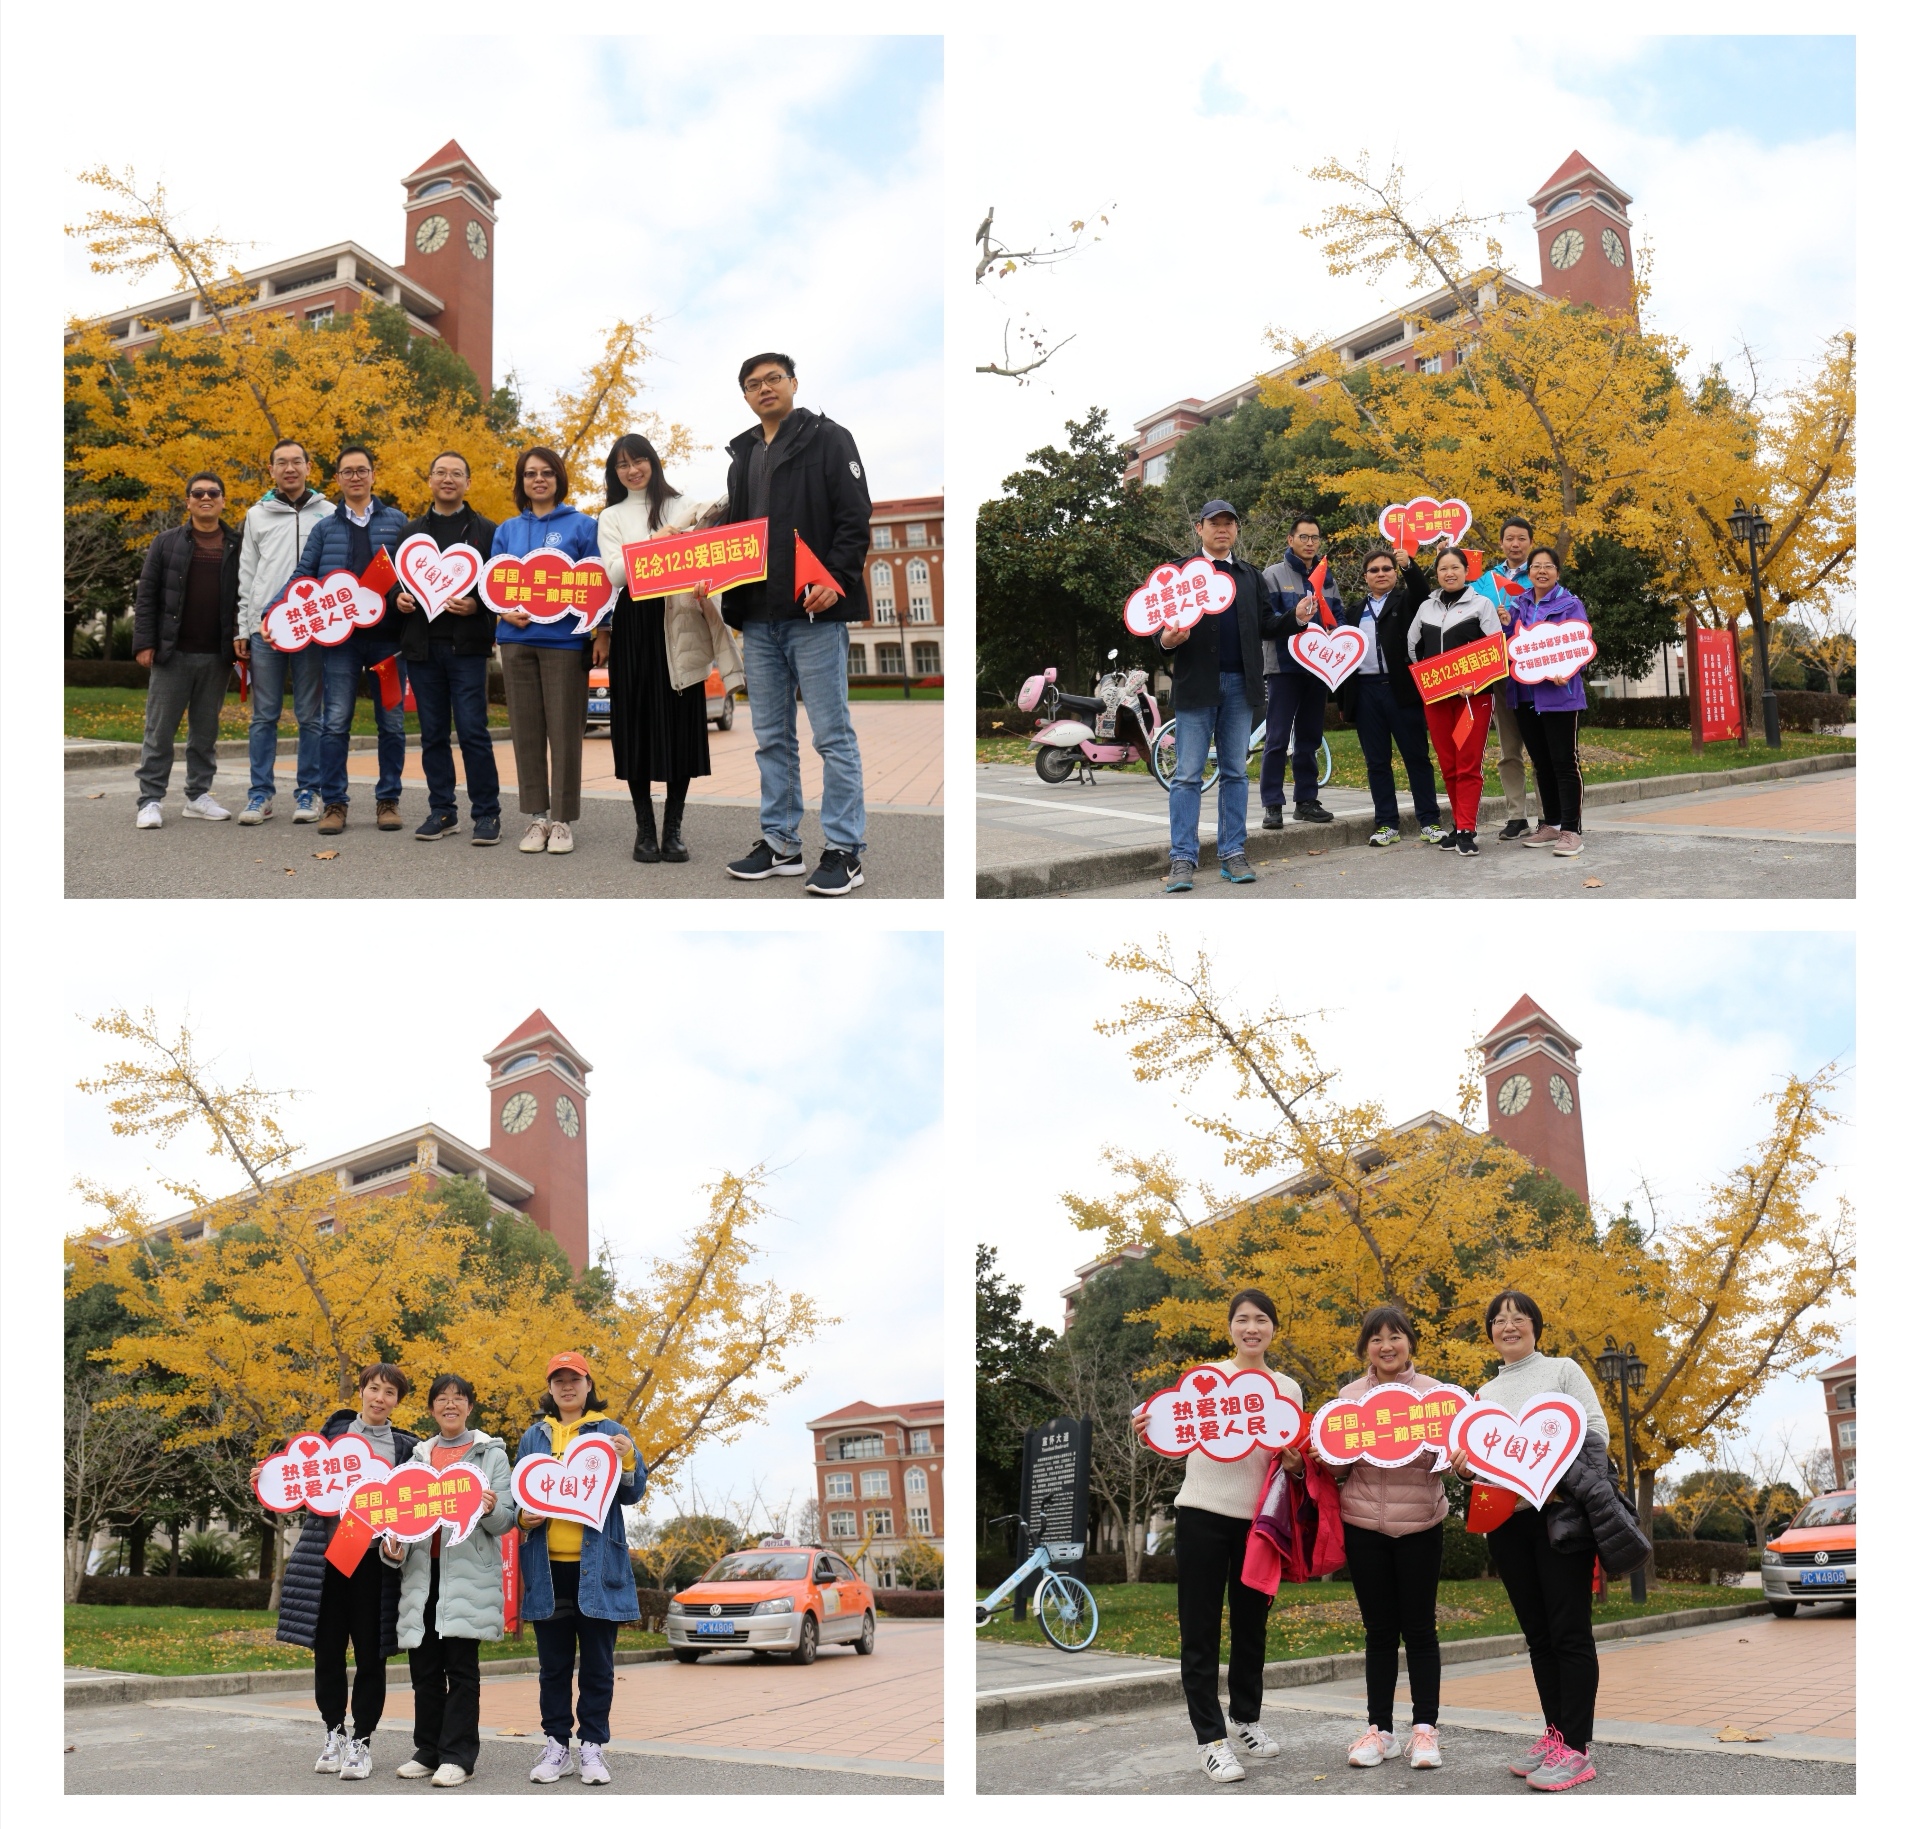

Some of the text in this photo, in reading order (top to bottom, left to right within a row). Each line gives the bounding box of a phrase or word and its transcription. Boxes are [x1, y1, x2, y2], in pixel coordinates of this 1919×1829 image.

[1397, 519, 1453, 533] 是一种责任
[634, 533, 760, 580] 纪念12.9爱国运动
[413, 555, 454, 593] 中国梦
[493, 568, 603, 587] 爱国，是一种情怀
[286, 588, 353, 624] 热爱祖国
[505, 586, 587, 604] 更是一种责任
[1144, 574, 1207, 609] 热爱祖国
[1147, 589, 1210, 625] 热爱人民
[292, 603, 359, 641] 热爱人民
[1307, 639, 1346, 669] 中国梦
[1420, 644, 1501, 689] 纪念12.9爱国运动
[1172, 1393, 1265, 1422] 热爱祖国
[1327, 1399, 1457, 1433] 爱国，是一种情怀
[1174, 1416, 1267, 1445] 热爱人民
[1344, 1421, 1443, 1450] 更是一种责任
[1483, 1426, 1552, 1470] 中国梦
[281, 1454, 362, 1482] 热爱祖国
[355, 1476, 472, 1510] 爱国，是一种情怀
[540, 1473, 599, 1503] 中国梦
[369, 1497, 458, 1526] 更是一种责任
